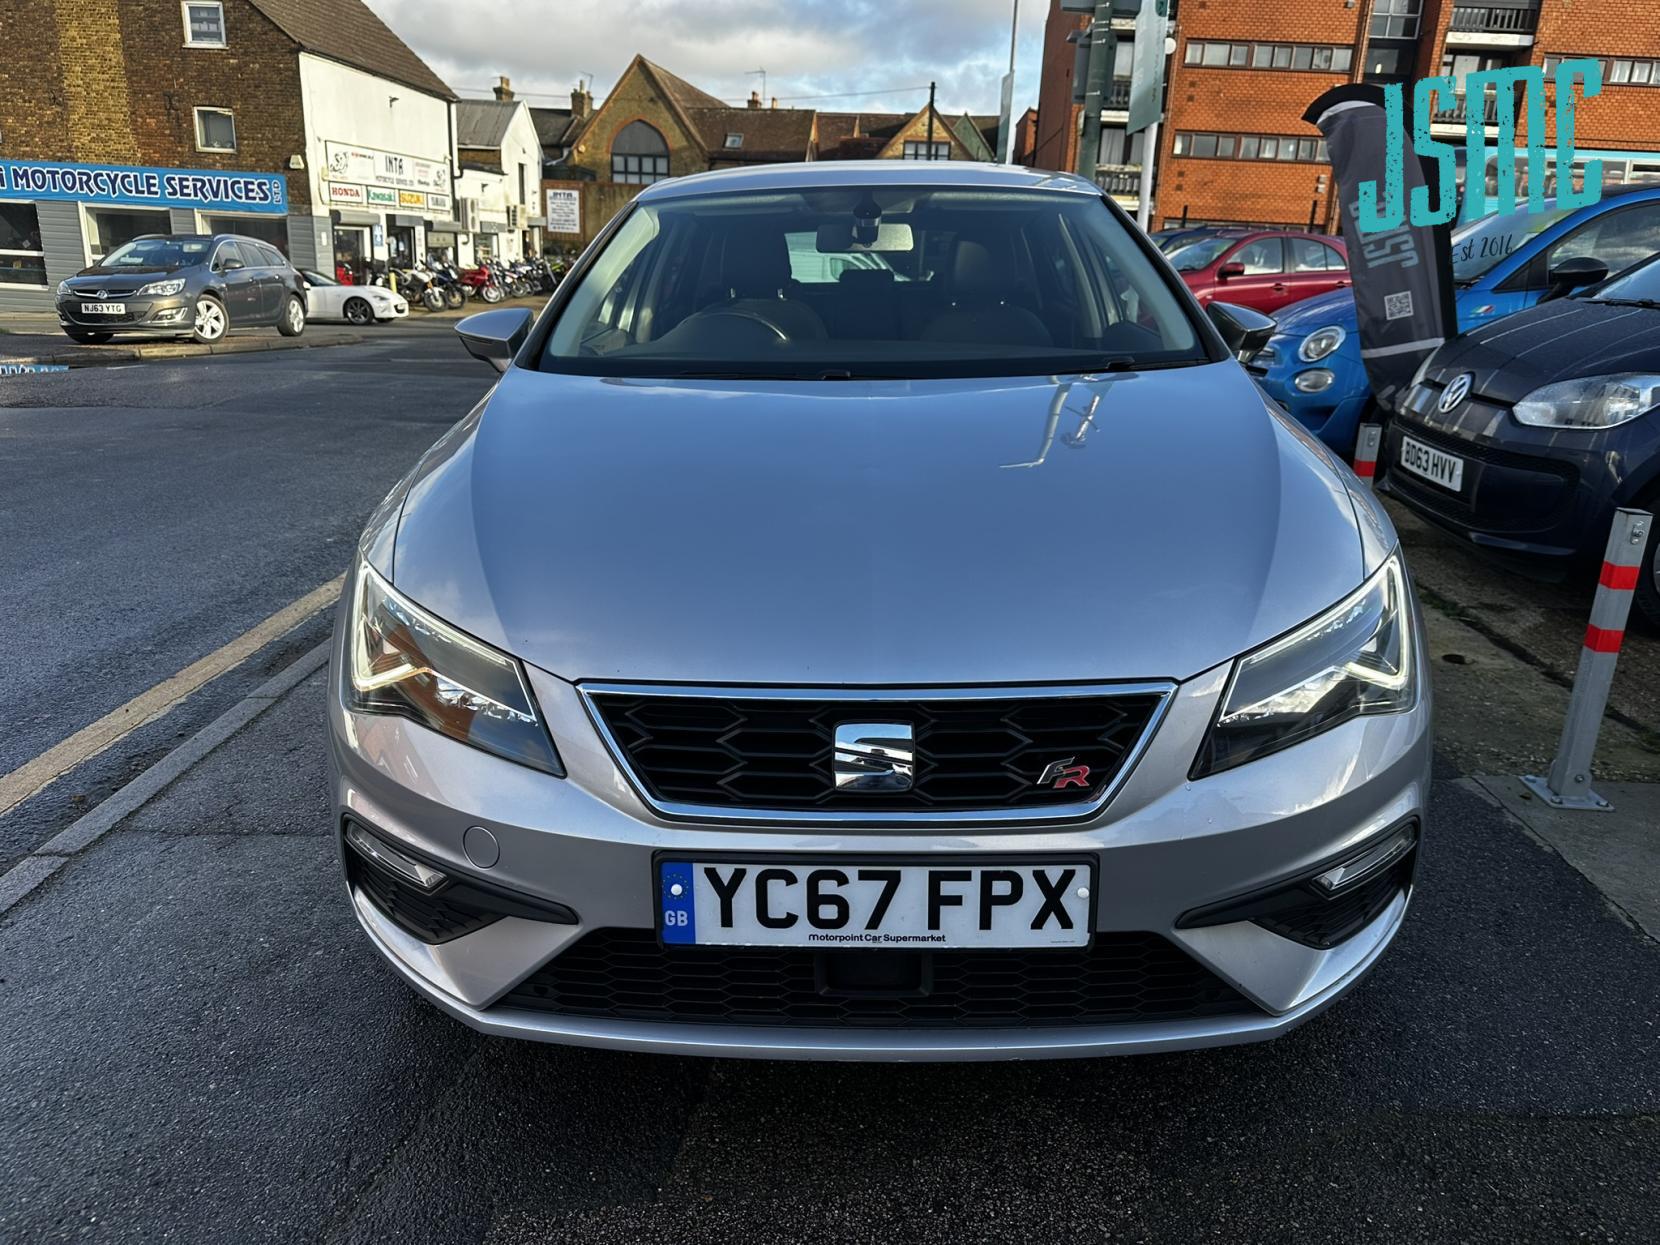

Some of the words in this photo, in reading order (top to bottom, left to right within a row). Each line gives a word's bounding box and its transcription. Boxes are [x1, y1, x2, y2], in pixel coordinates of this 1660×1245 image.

[11, 166, 161, 198] MOTORCYCLE
[164, 175, 271, 204] SERVICES
[272, 180, 282, 204] LTD
[331, 187, 361, 198] HONDA
[84, 304, 104, 313] NJ63
[1430, 453, 1456, 484] HVV
[1036, 756, 1091, 789] FR
[704, 867, 902, 930] YC67
[926, 869, 1077, 931] FPX
[664, 910, 688, 926] GB
[808, 933, 864, 943] Motorpoint
[864, 933, 882, 942] Car
[883, 933, 946, 943] Supermarket
